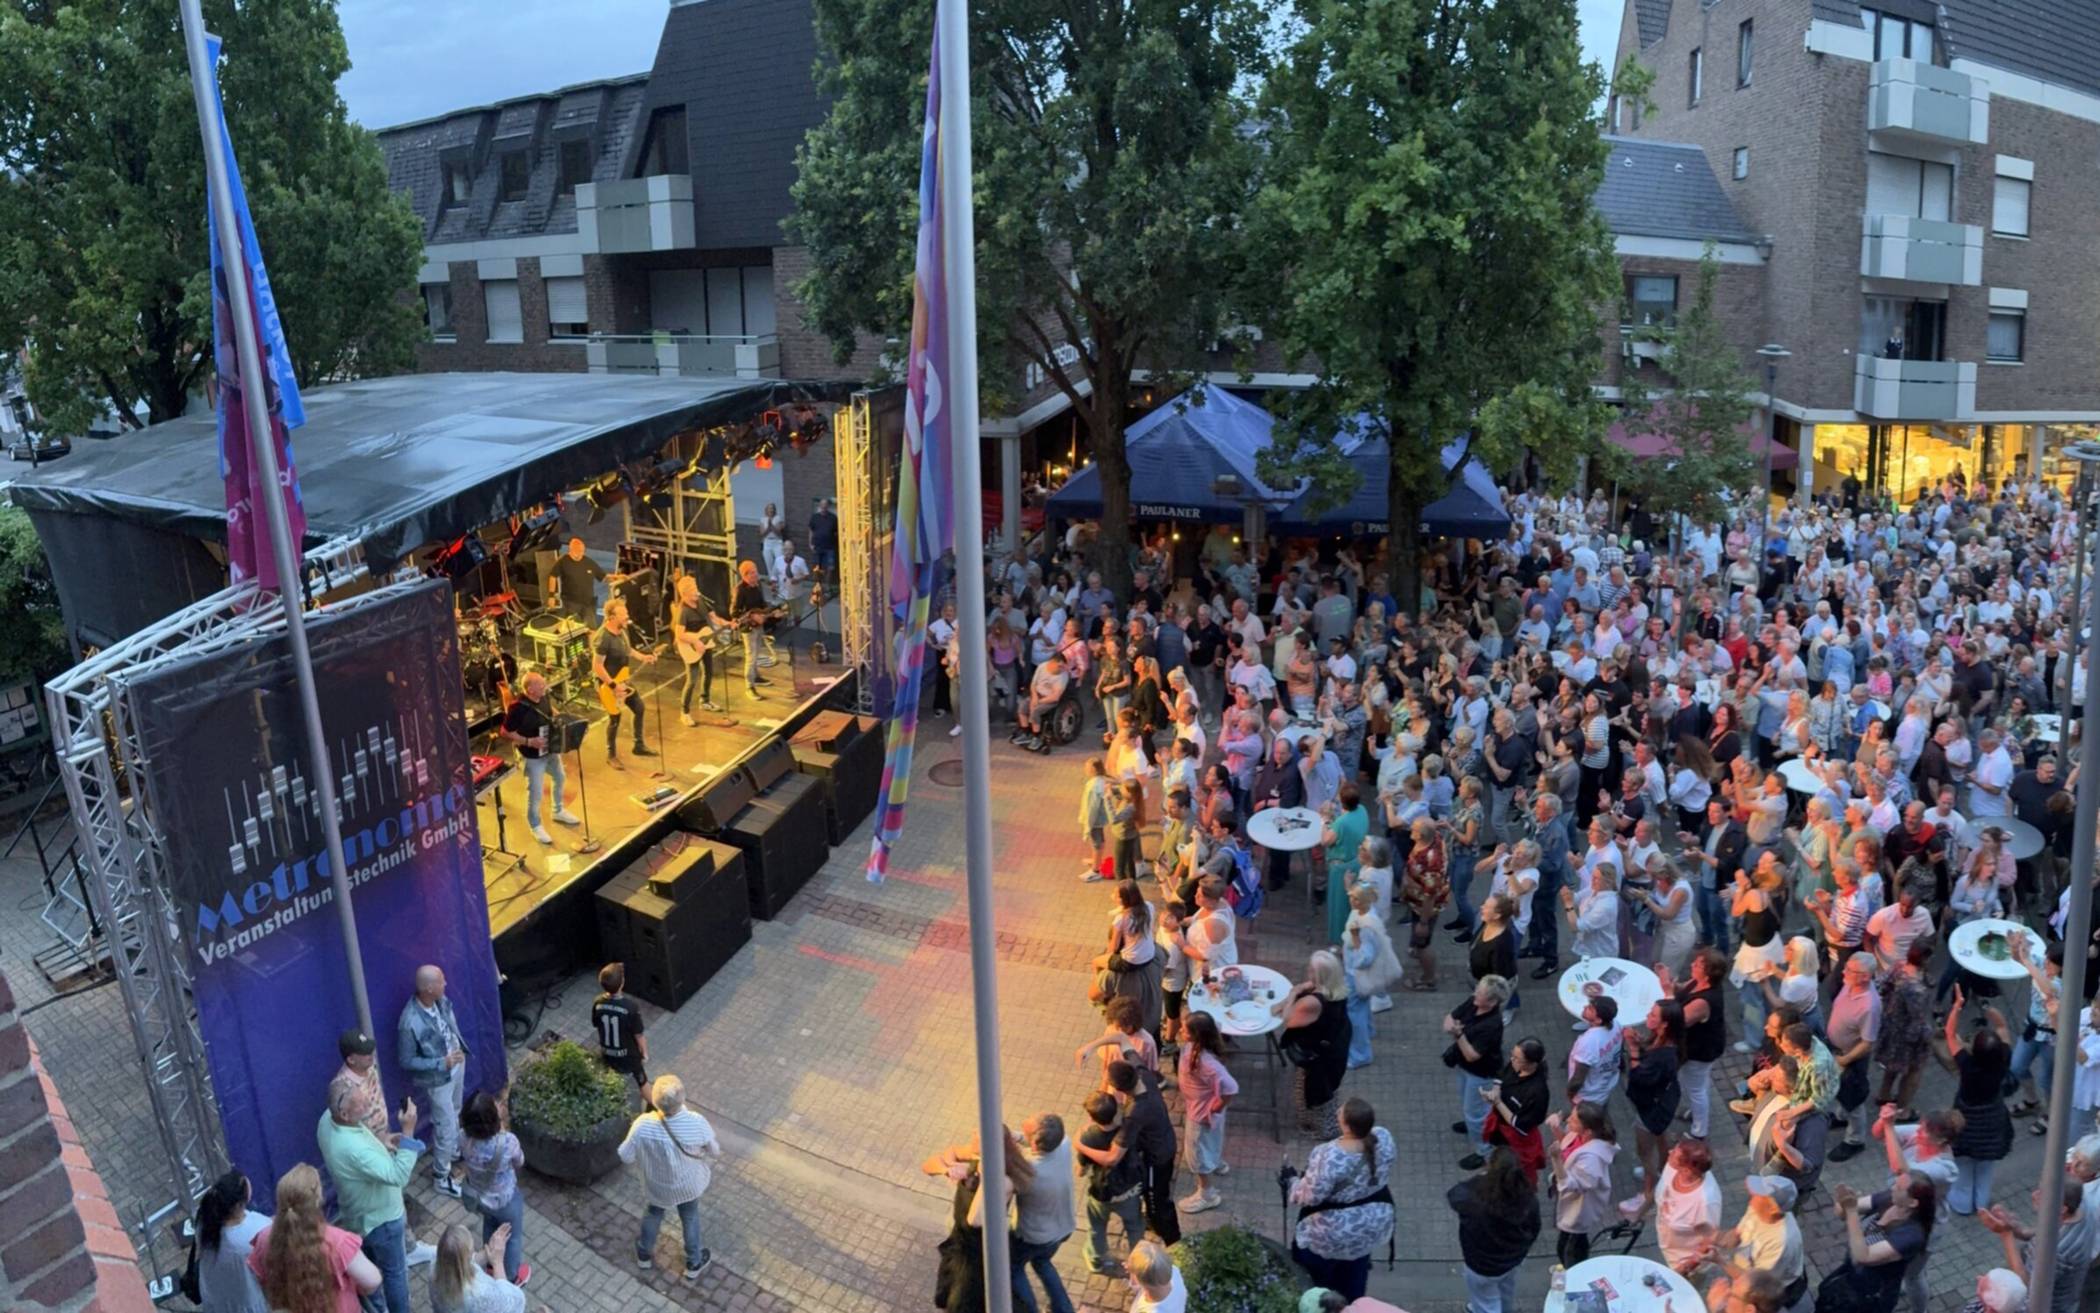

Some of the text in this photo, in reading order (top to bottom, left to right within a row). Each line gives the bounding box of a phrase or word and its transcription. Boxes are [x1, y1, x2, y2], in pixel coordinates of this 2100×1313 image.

[1140, 505, 1201, 519] PAULANER
[198, 810, 470, 966] Veranstaltunstechnik GmbH
[601, 1014, 620, 1048] 11
